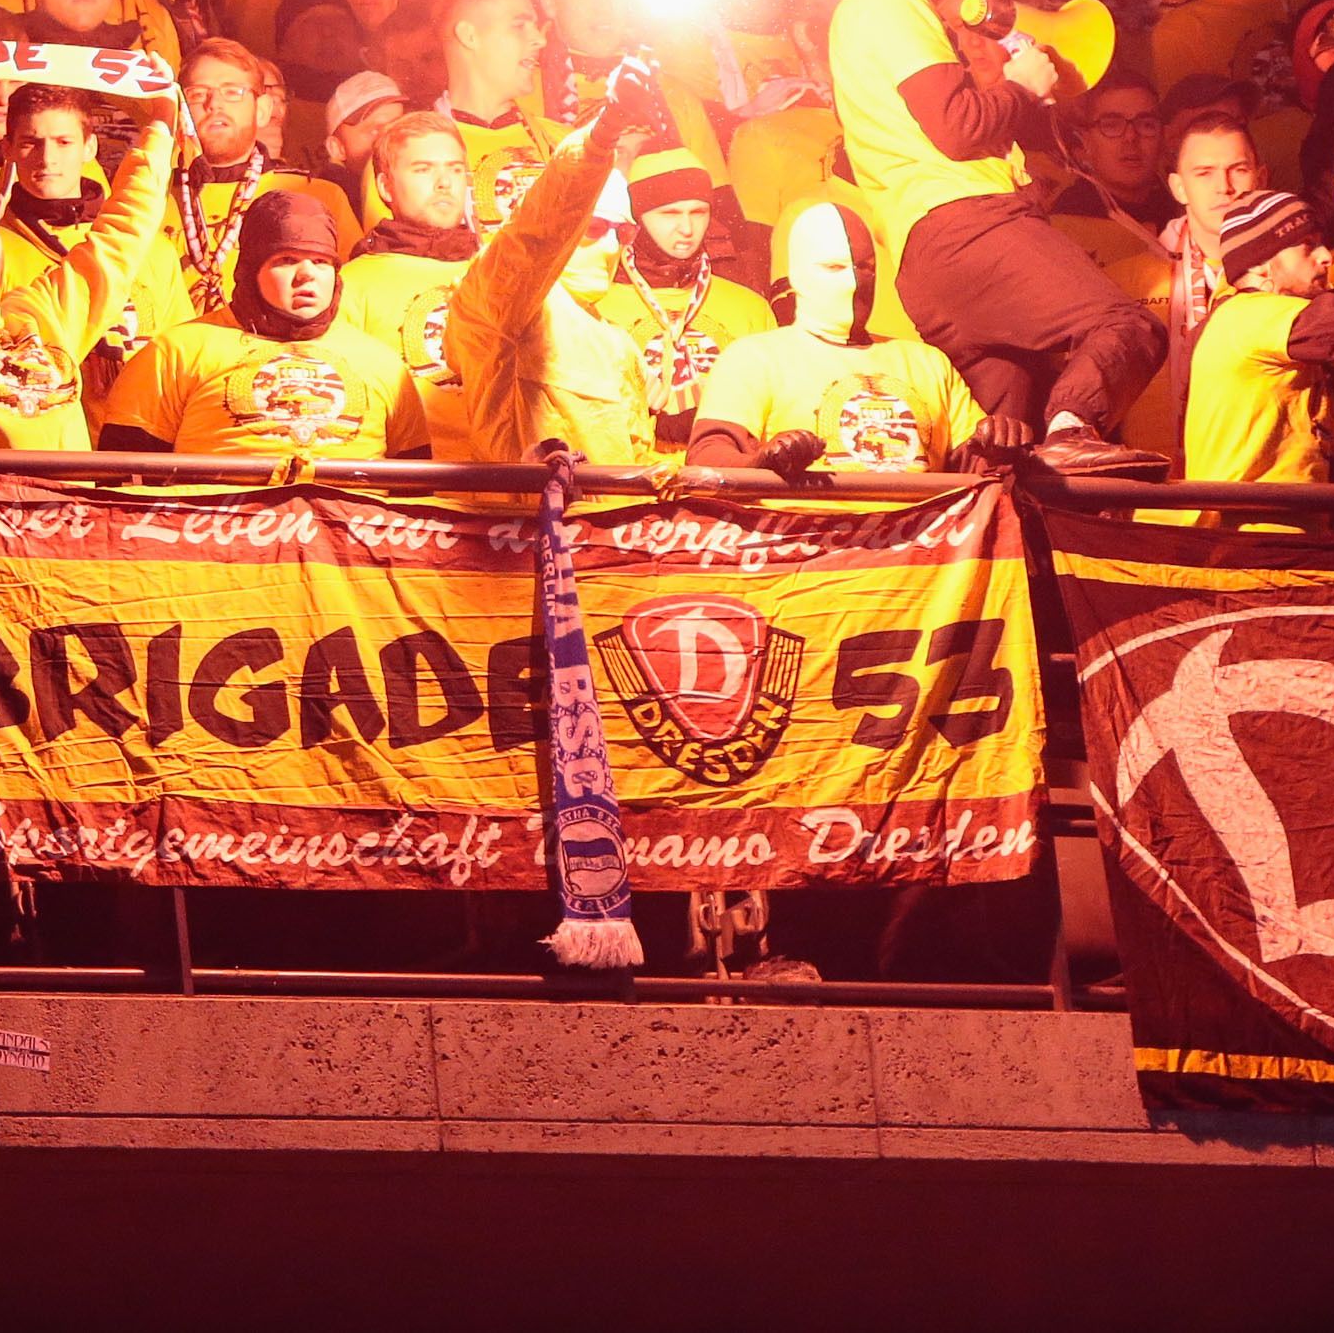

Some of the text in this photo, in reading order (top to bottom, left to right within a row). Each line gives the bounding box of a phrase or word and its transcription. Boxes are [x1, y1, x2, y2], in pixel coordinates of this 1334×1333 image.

[121, 495, 319, 547] Leben
[346, 513, 459, 551] nur
[831, 617, 1015, 751] 53
[631, 693, 789, 783] DRESDEN
[525, 812, 776, 869] namo
[800, 806, 1037, 864] Dresden
